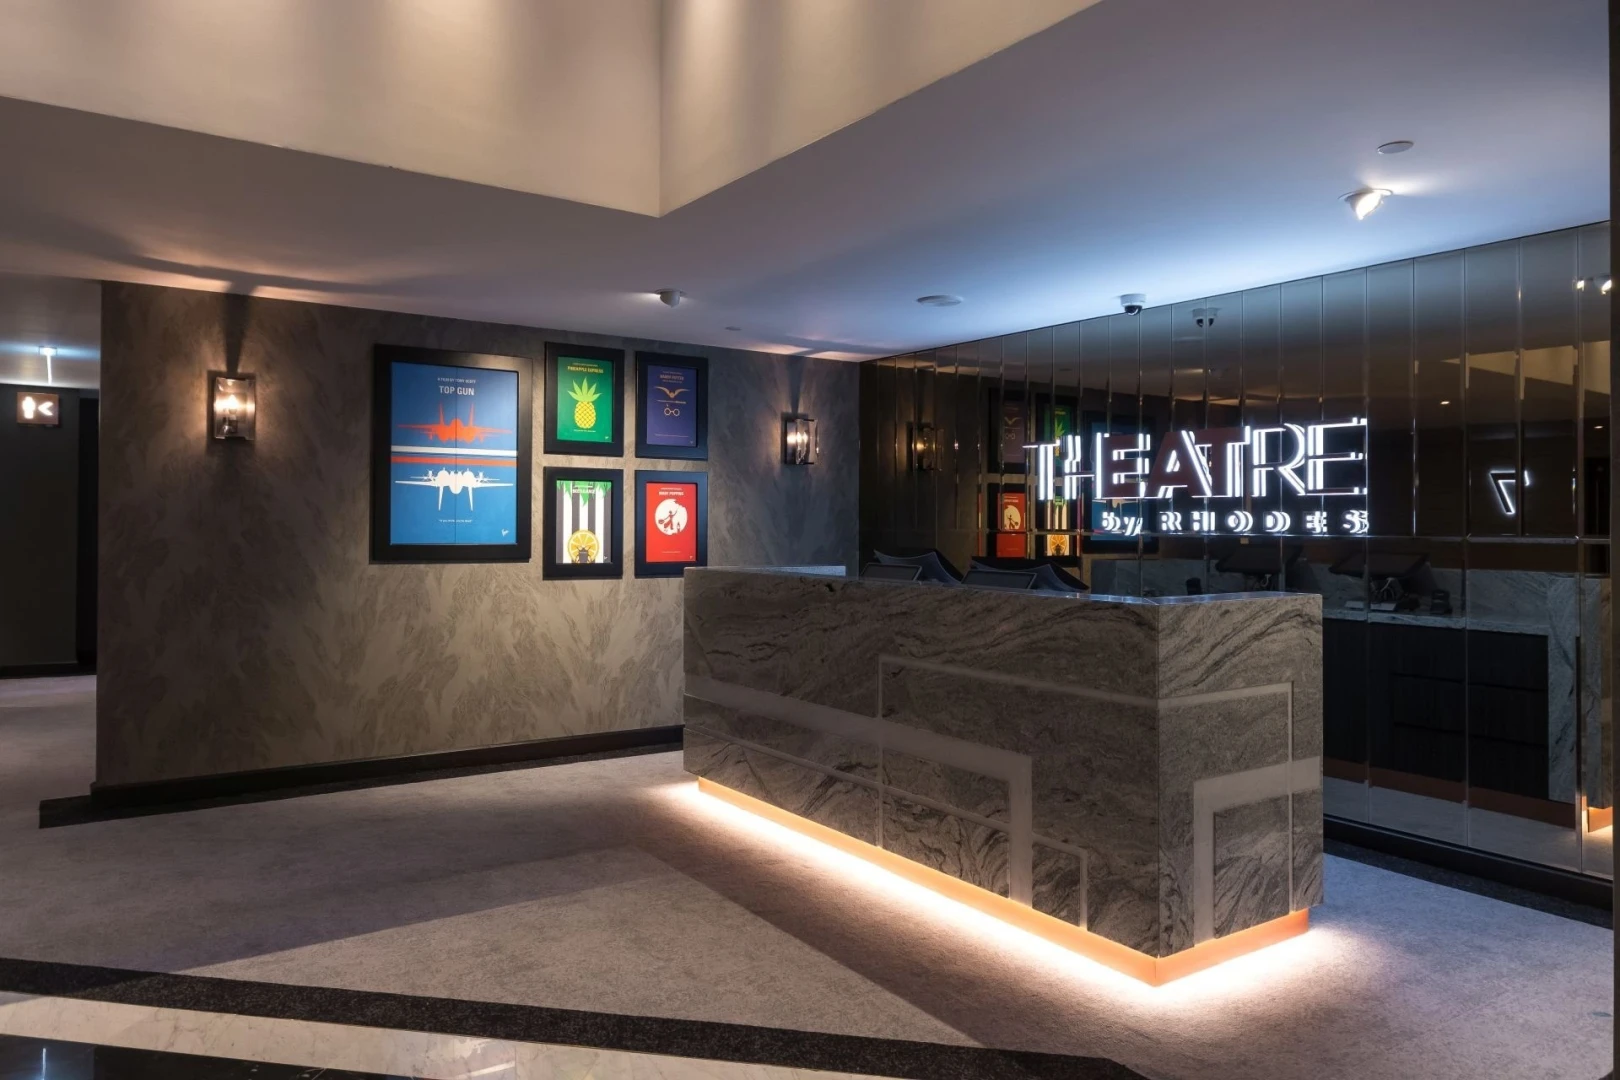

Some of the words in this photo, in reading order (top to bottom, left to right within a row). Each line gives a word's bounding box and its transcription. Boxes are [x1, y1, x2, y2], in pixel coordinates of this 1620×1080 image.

[438, 385, 456, 395] TOP
[456, 387, 475, 396] GUN
[1022, 418, 1368, 501] THEATRE
[1158, 510, 1370, 534] RHODES
